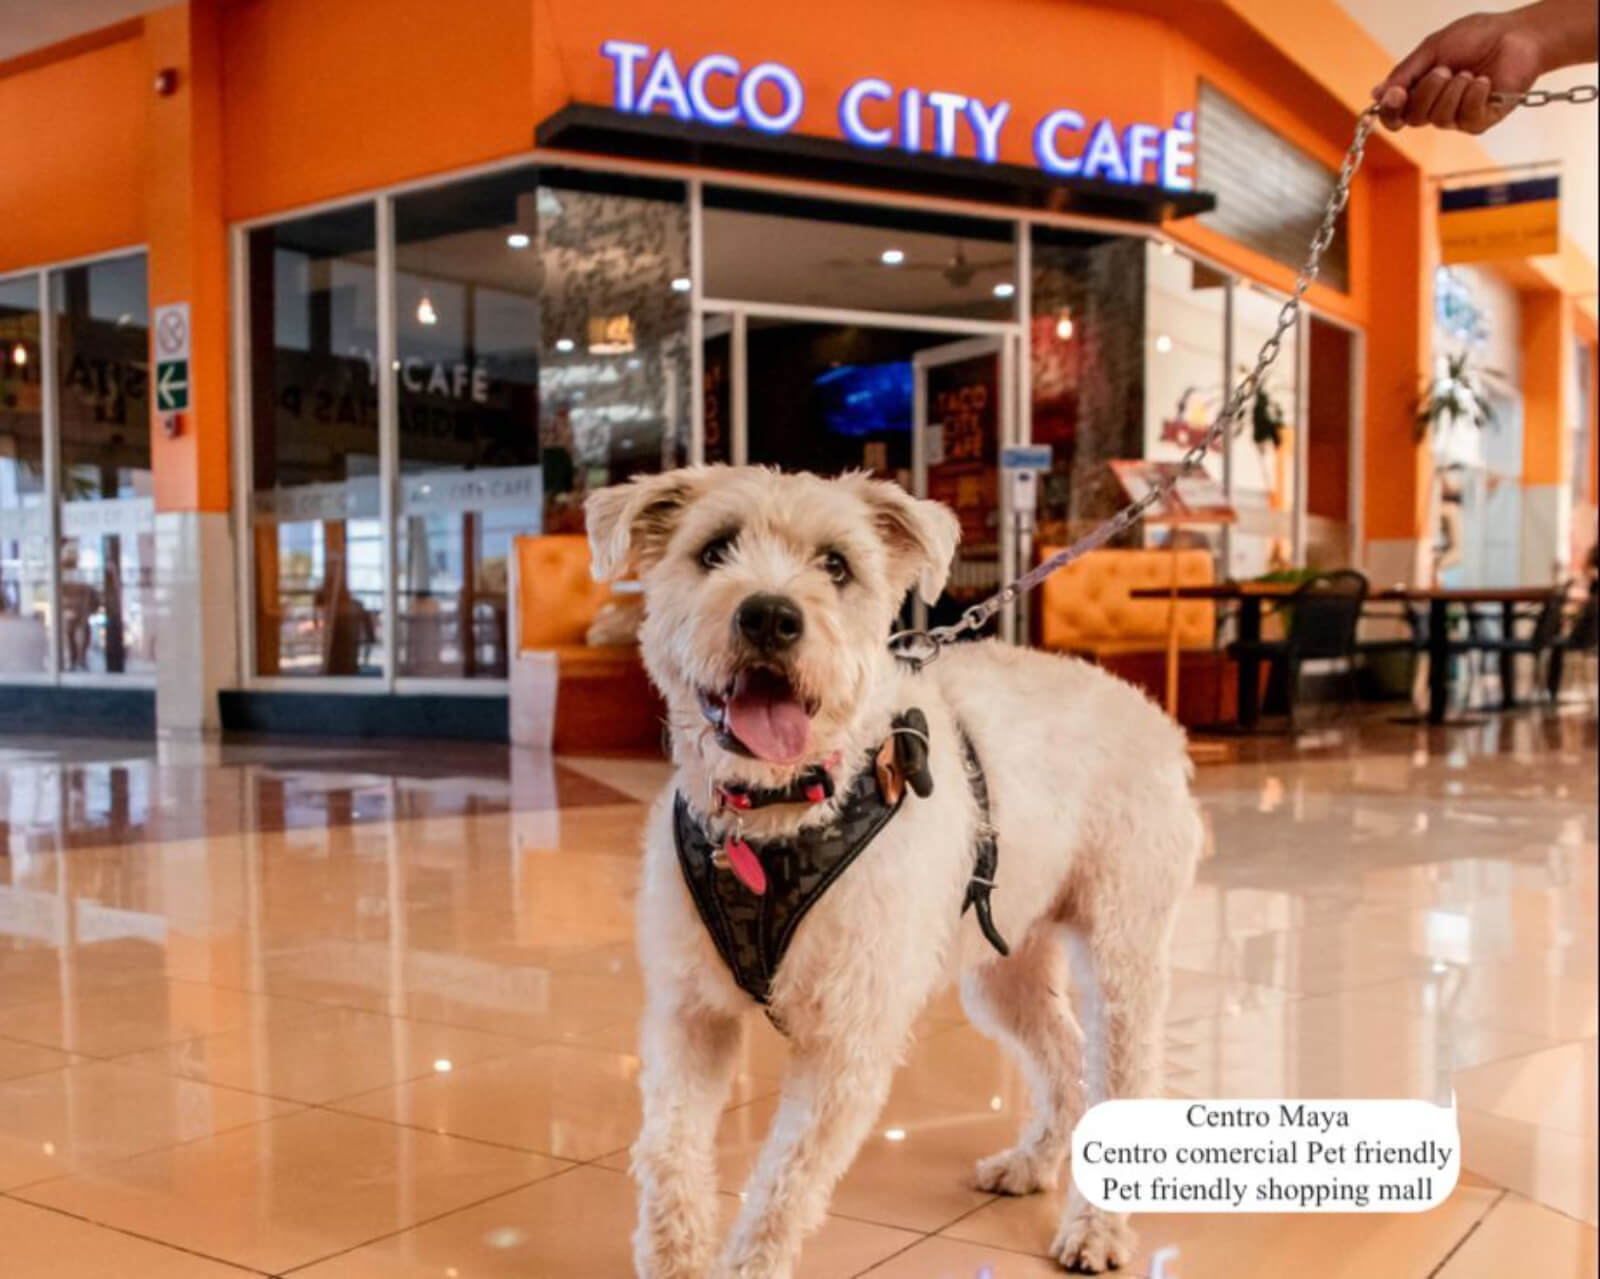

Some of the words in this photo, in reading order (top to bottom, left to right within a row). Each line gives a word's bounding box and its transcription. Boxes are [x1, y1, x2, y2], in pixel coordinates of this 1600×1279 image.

[603, 40, 804, 132] TACO
[838, 77, 1010, 163] CITY
[1034, 109, 1195, 191] CAFÉ
